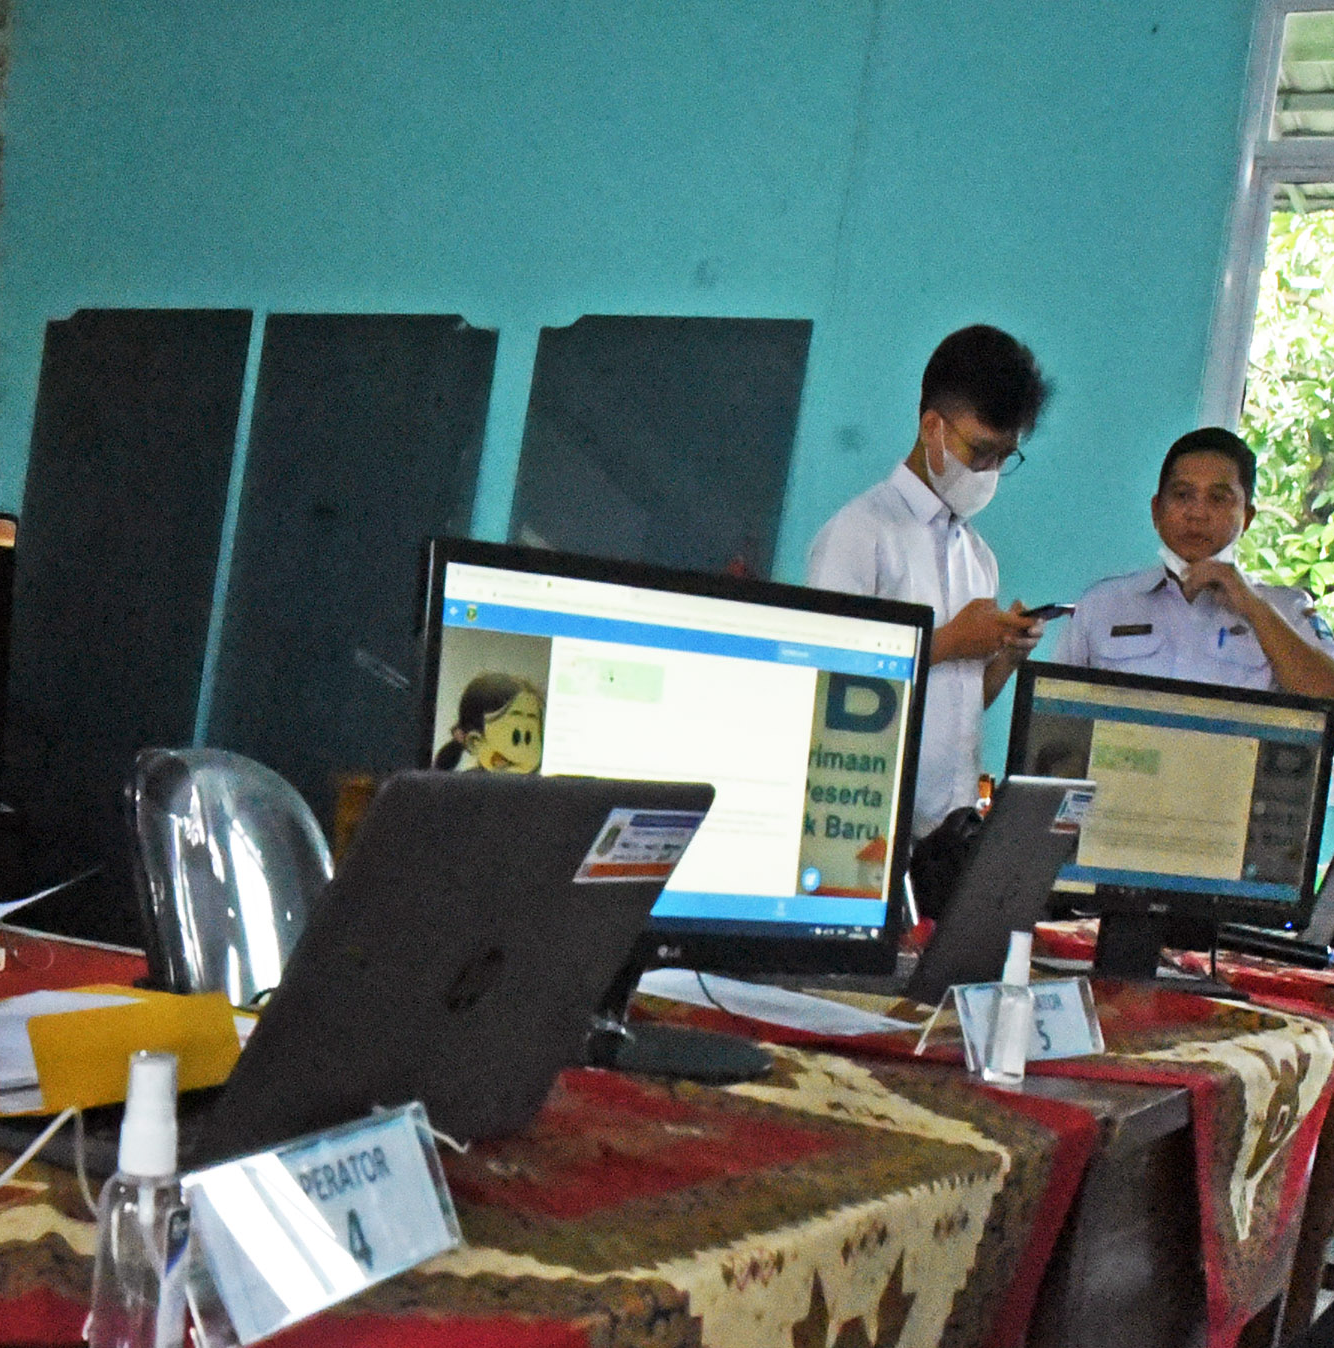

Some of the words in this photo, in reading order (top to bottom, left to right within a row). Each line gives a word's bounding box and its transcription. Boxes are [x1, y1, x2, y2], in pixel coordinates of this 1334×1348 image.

[805, 777, 883, 808] eserta
[825, 814, 879, 842] Baru
[1035, 1019, 1051, 1051] 5
[299, 1147, 390, 1200] PERATOR
[348, 1209, 373, 1271] 4
